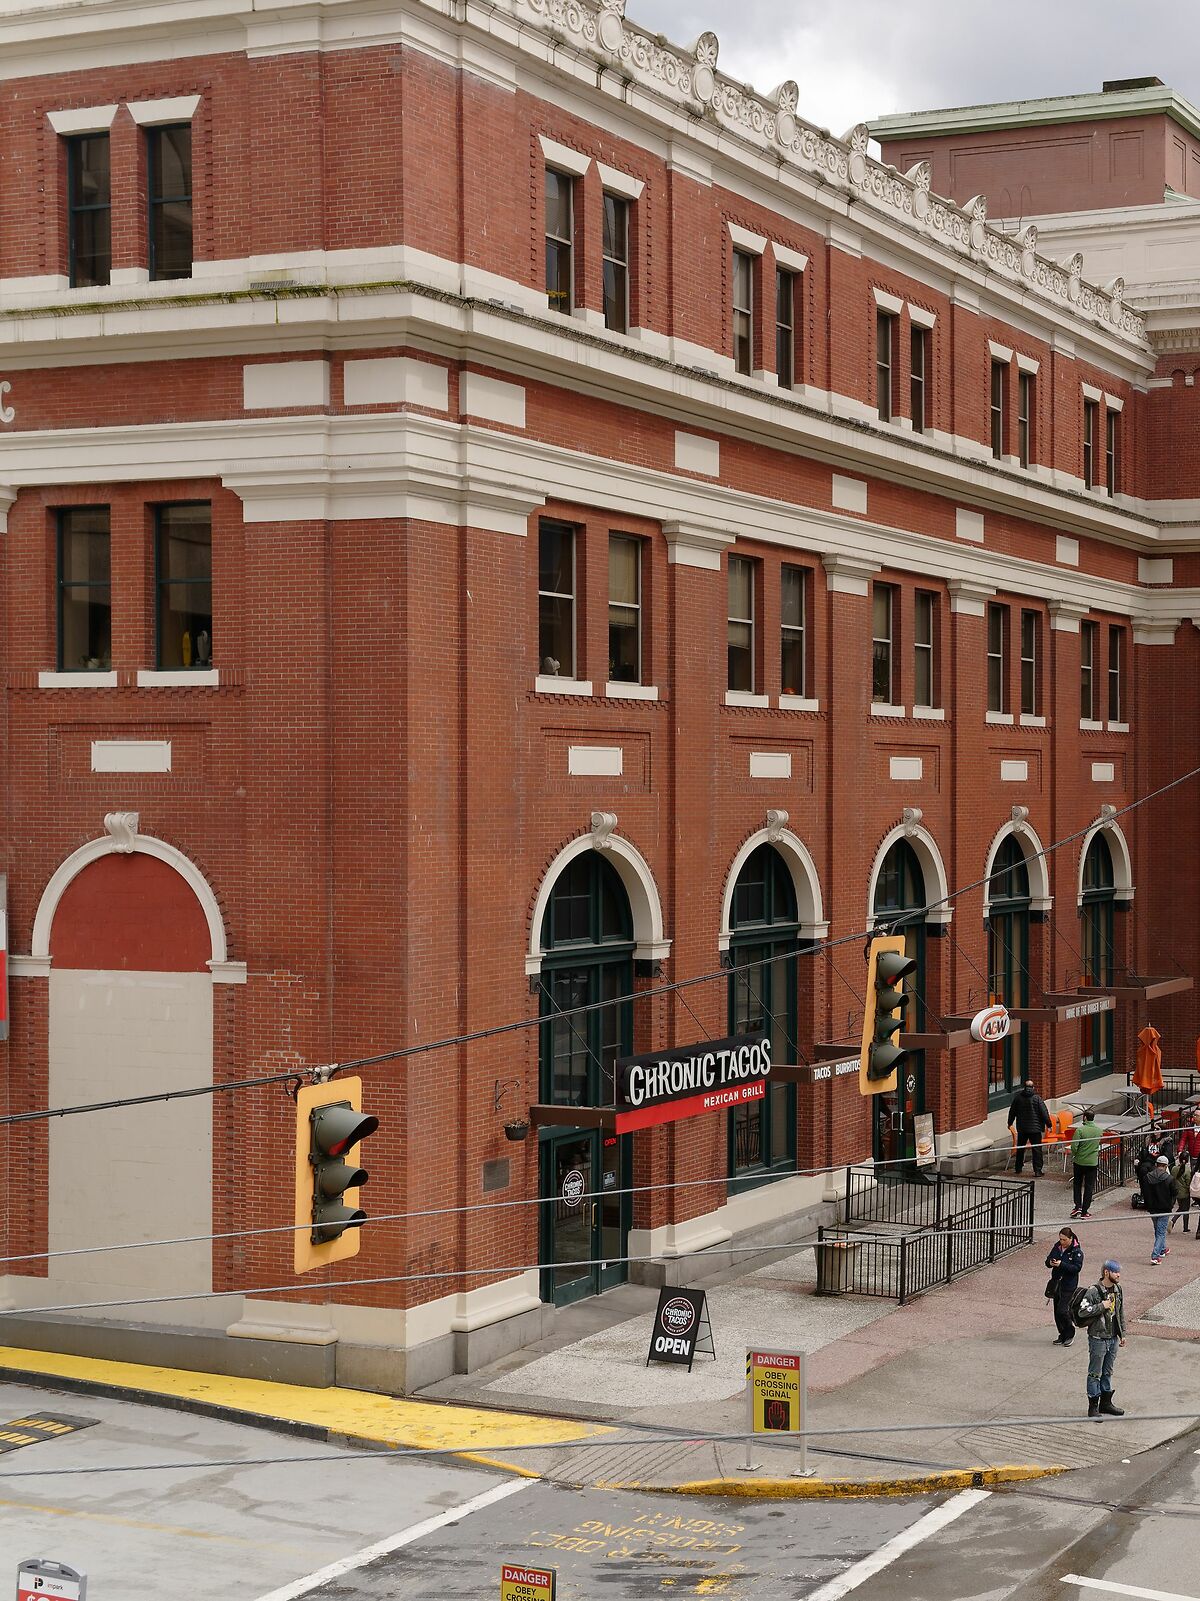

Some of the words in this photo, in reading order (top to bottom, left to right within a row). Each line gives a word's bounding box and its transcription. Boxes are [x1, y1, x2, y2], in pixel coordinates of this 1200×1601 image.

[984, 1018, 1008, 1037] A&W
[629, 1052, 715, 1106] CHRONIC
[716, 1038, 771, 1084] TACOS
[814, 1066, 831, 1080] TACOS
[836, 1059, 861, 1075] BURRITOS
[703, 1090, 739, 1108] MEXICAN
[742, 1085, 764, 1099] GRILL
[604, 1137, 617, 1147] OPEN
[564, 1179, 583, 1191] CHRONIC
[665, 1307, 692, 1319] CHRONIC
[667, 1315, 688, 1326] TACOS
[655, 1336, 691, 1356] OPEN
[757, 1355, 795, 1367] DANGER
[764, 1371, 787, 1380] OBEY
[754, 1379, 798, 1391] CROSSING
[760, 1388, 791, 1399] SIGNAL
[504, 1569, 548, 1586] DANGER
[515, 1585, 537, 1596] OBEY
